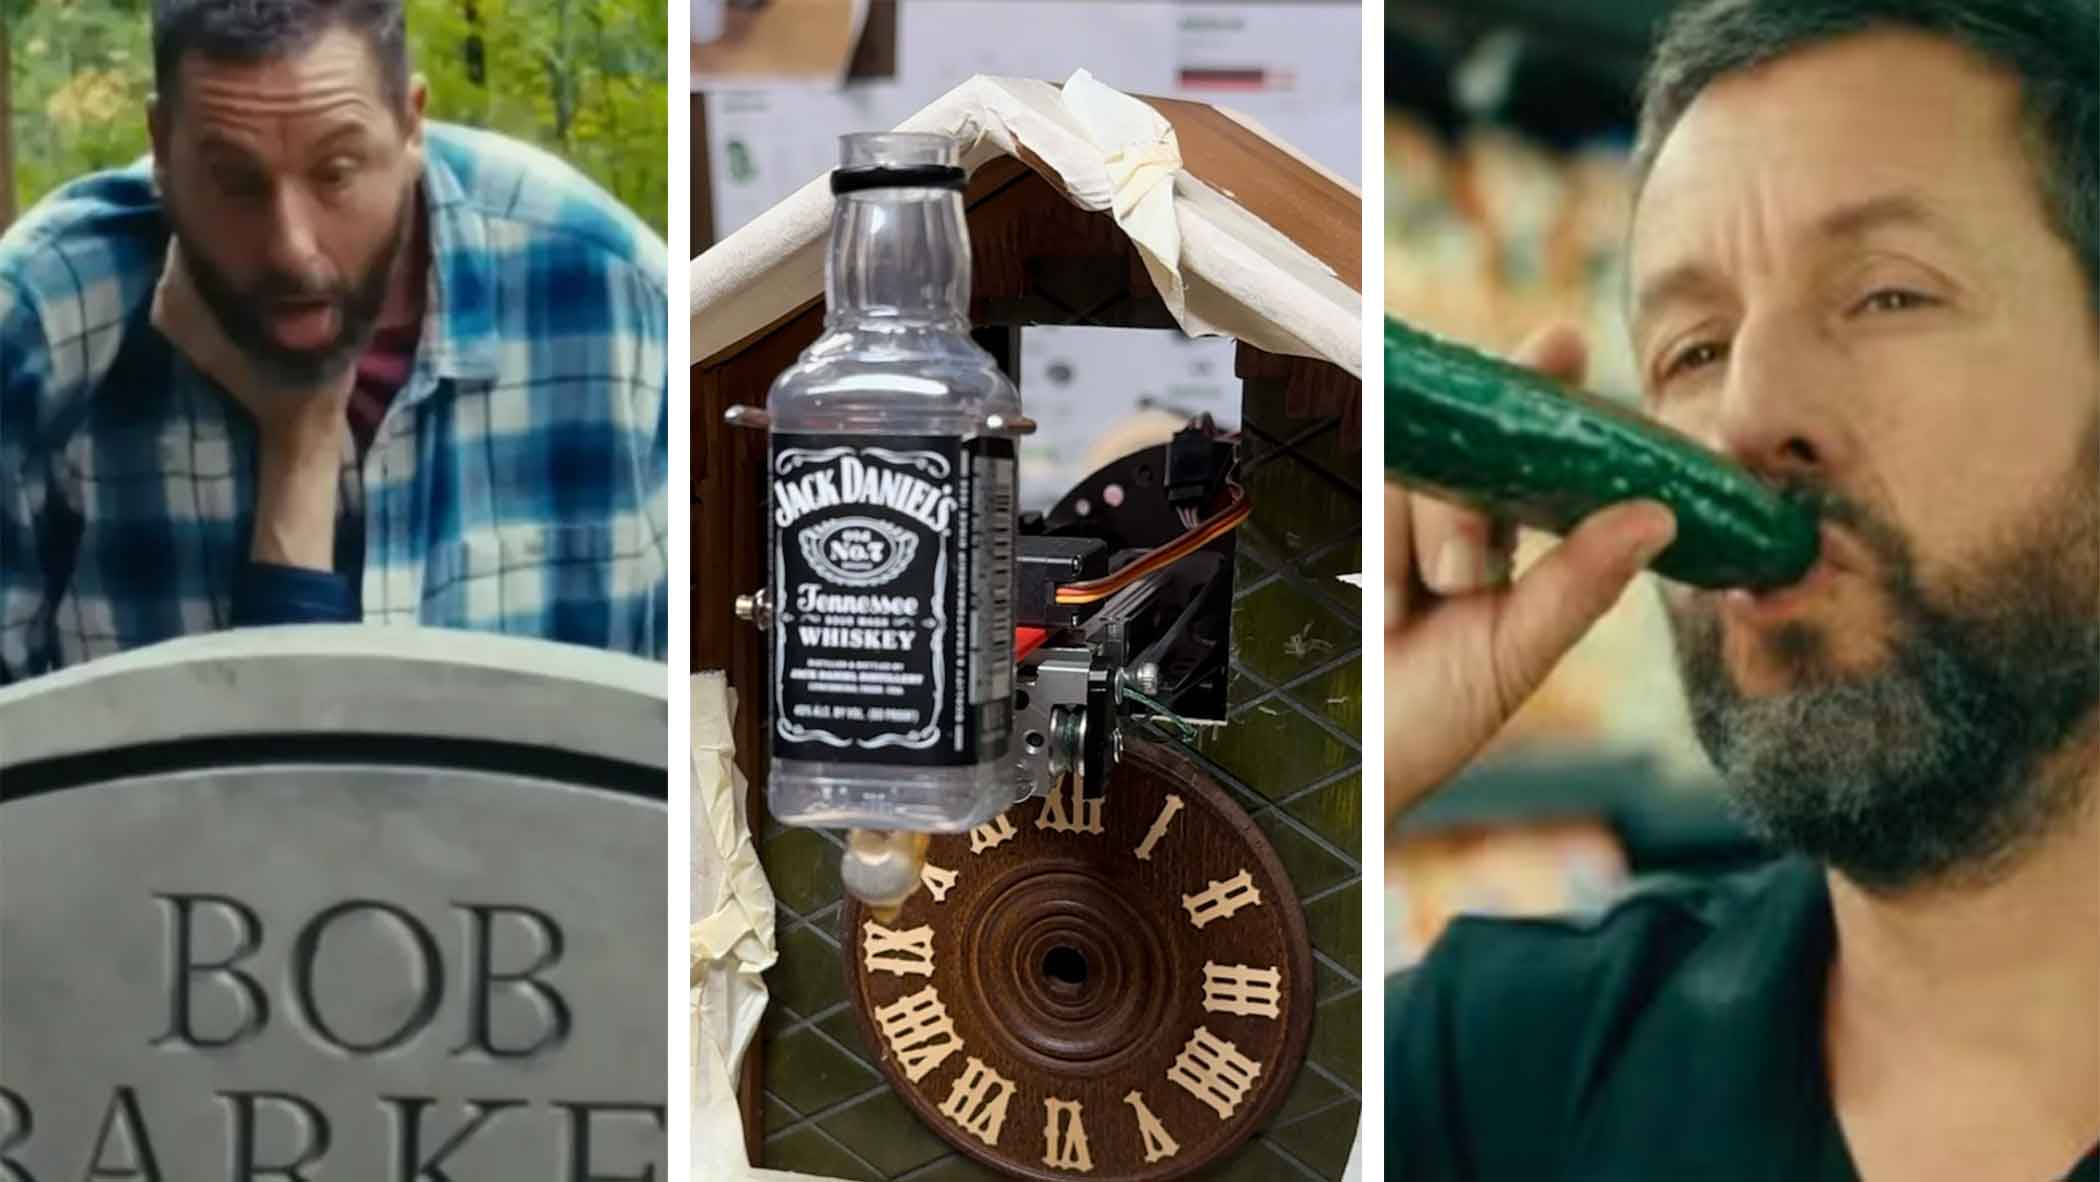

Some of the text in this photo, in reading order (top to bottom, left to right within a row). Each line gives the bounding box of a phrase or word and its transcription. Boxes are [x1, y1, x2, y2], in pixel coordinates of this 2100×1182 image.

[774, 467, 840, 528] JACK
[840, 455, 958, 533] DANIEL'S
[796, 582, 919, 616] Tennessee
[797, 625, 917, 651] WHISKEY
[144, 891, 573, 1061] BOB
[1202, 960, 1281, 1020] III
[0, 1084, 668, 1182] ARKE
